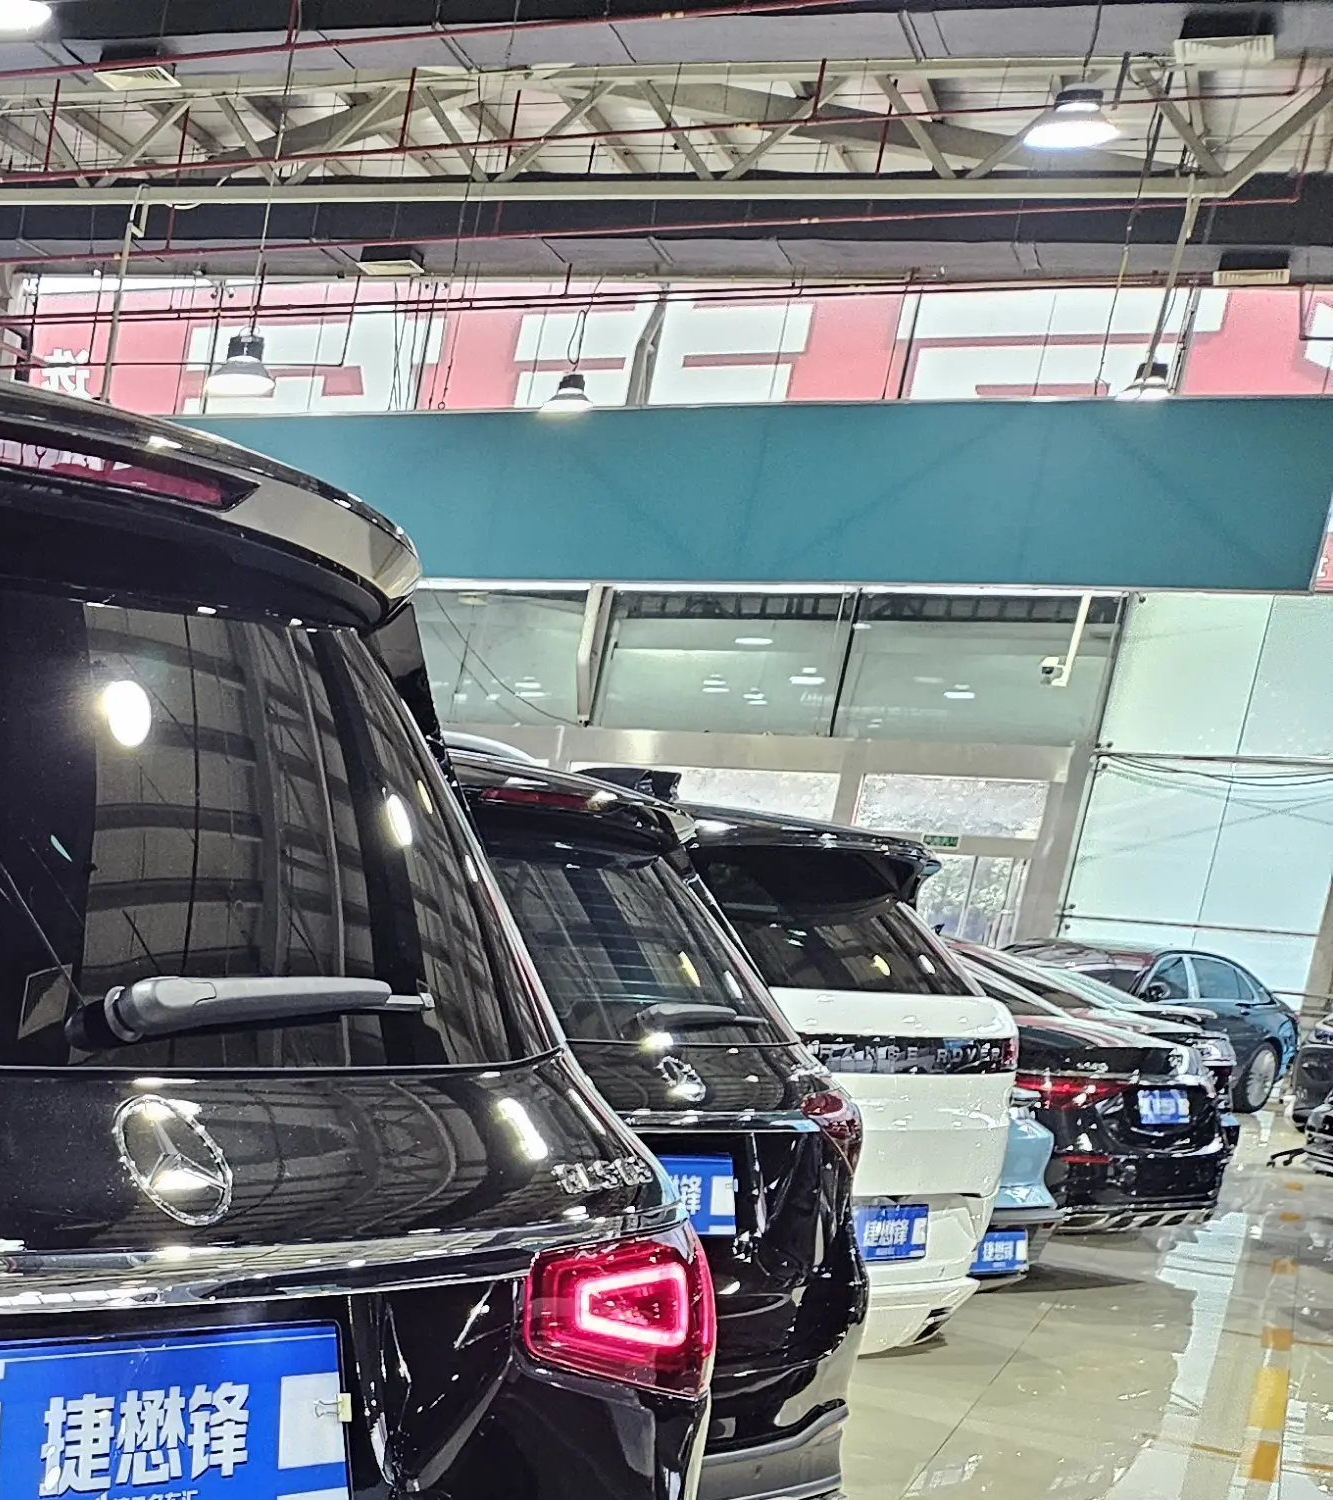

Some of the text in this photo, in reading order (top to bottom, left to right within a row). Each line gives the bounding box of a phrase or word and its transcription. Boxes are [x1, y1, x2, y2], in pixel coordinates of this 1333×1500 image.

[819, 1046, 1002, 1063] RANGE ROVER
[39, 1382, 249, 1497] 捷懋锋
